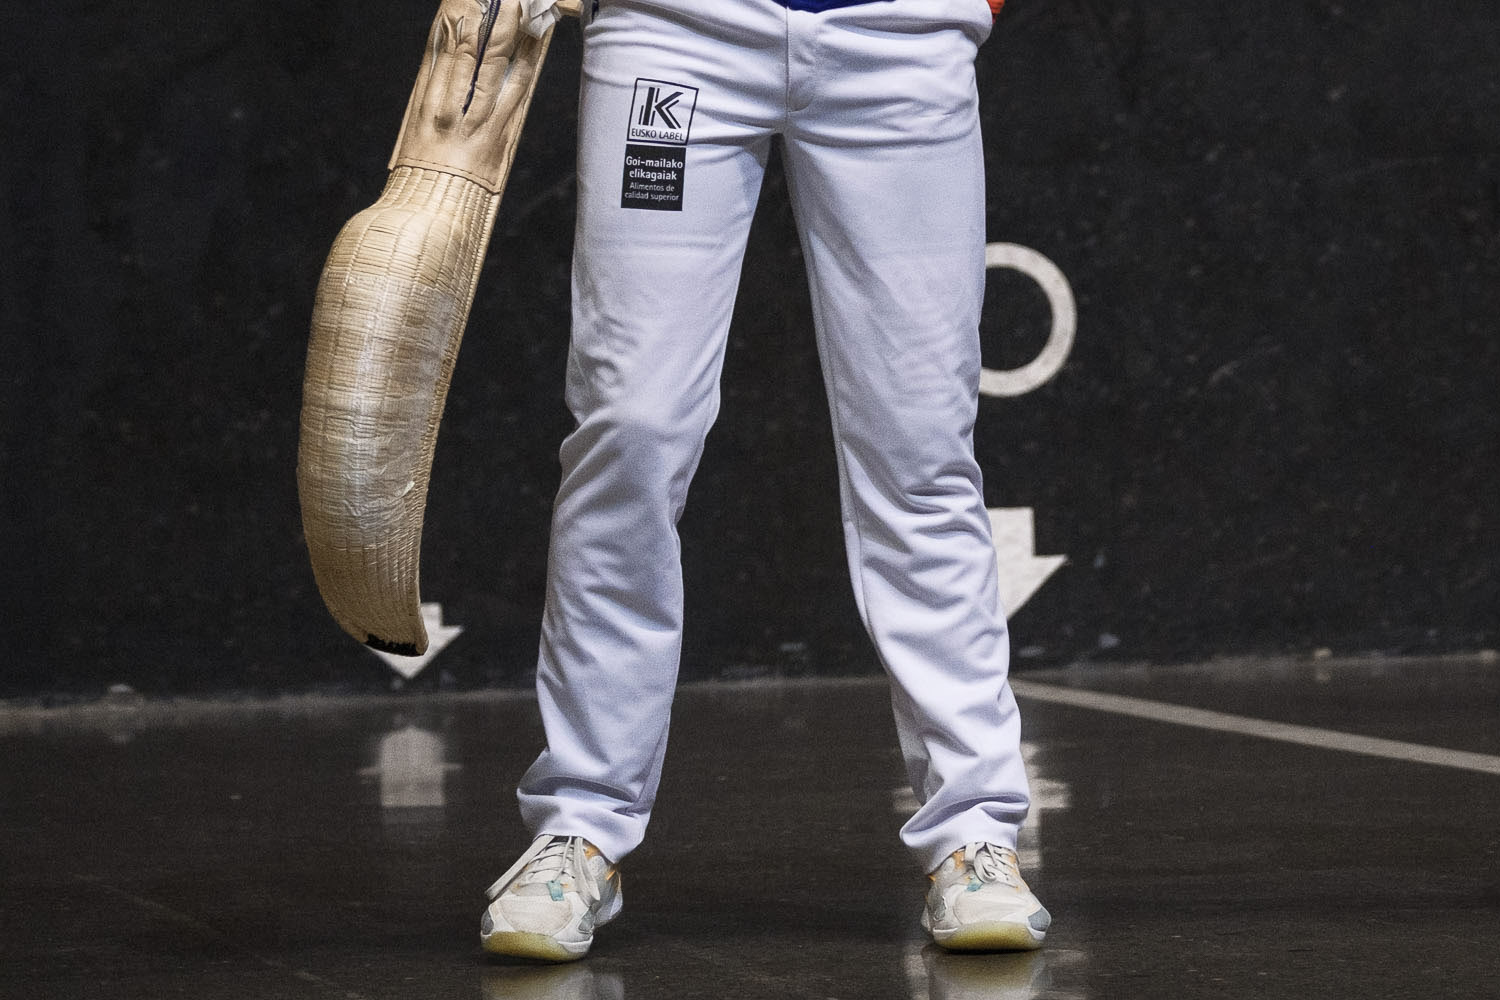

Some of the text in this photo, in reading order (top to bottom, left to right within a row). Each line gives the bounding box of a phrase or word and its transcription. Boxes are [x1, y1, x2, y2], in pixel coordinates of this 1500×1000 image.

[631, 128, 684, 141] EUSKO LABEL
[625, 155, 683, 169] Goi-mailako
[629, 169, 677, 182] elikagaiak
[629, 181, 675, 192] Alimentos de
[624, 190, 680, 203] calidad superior
